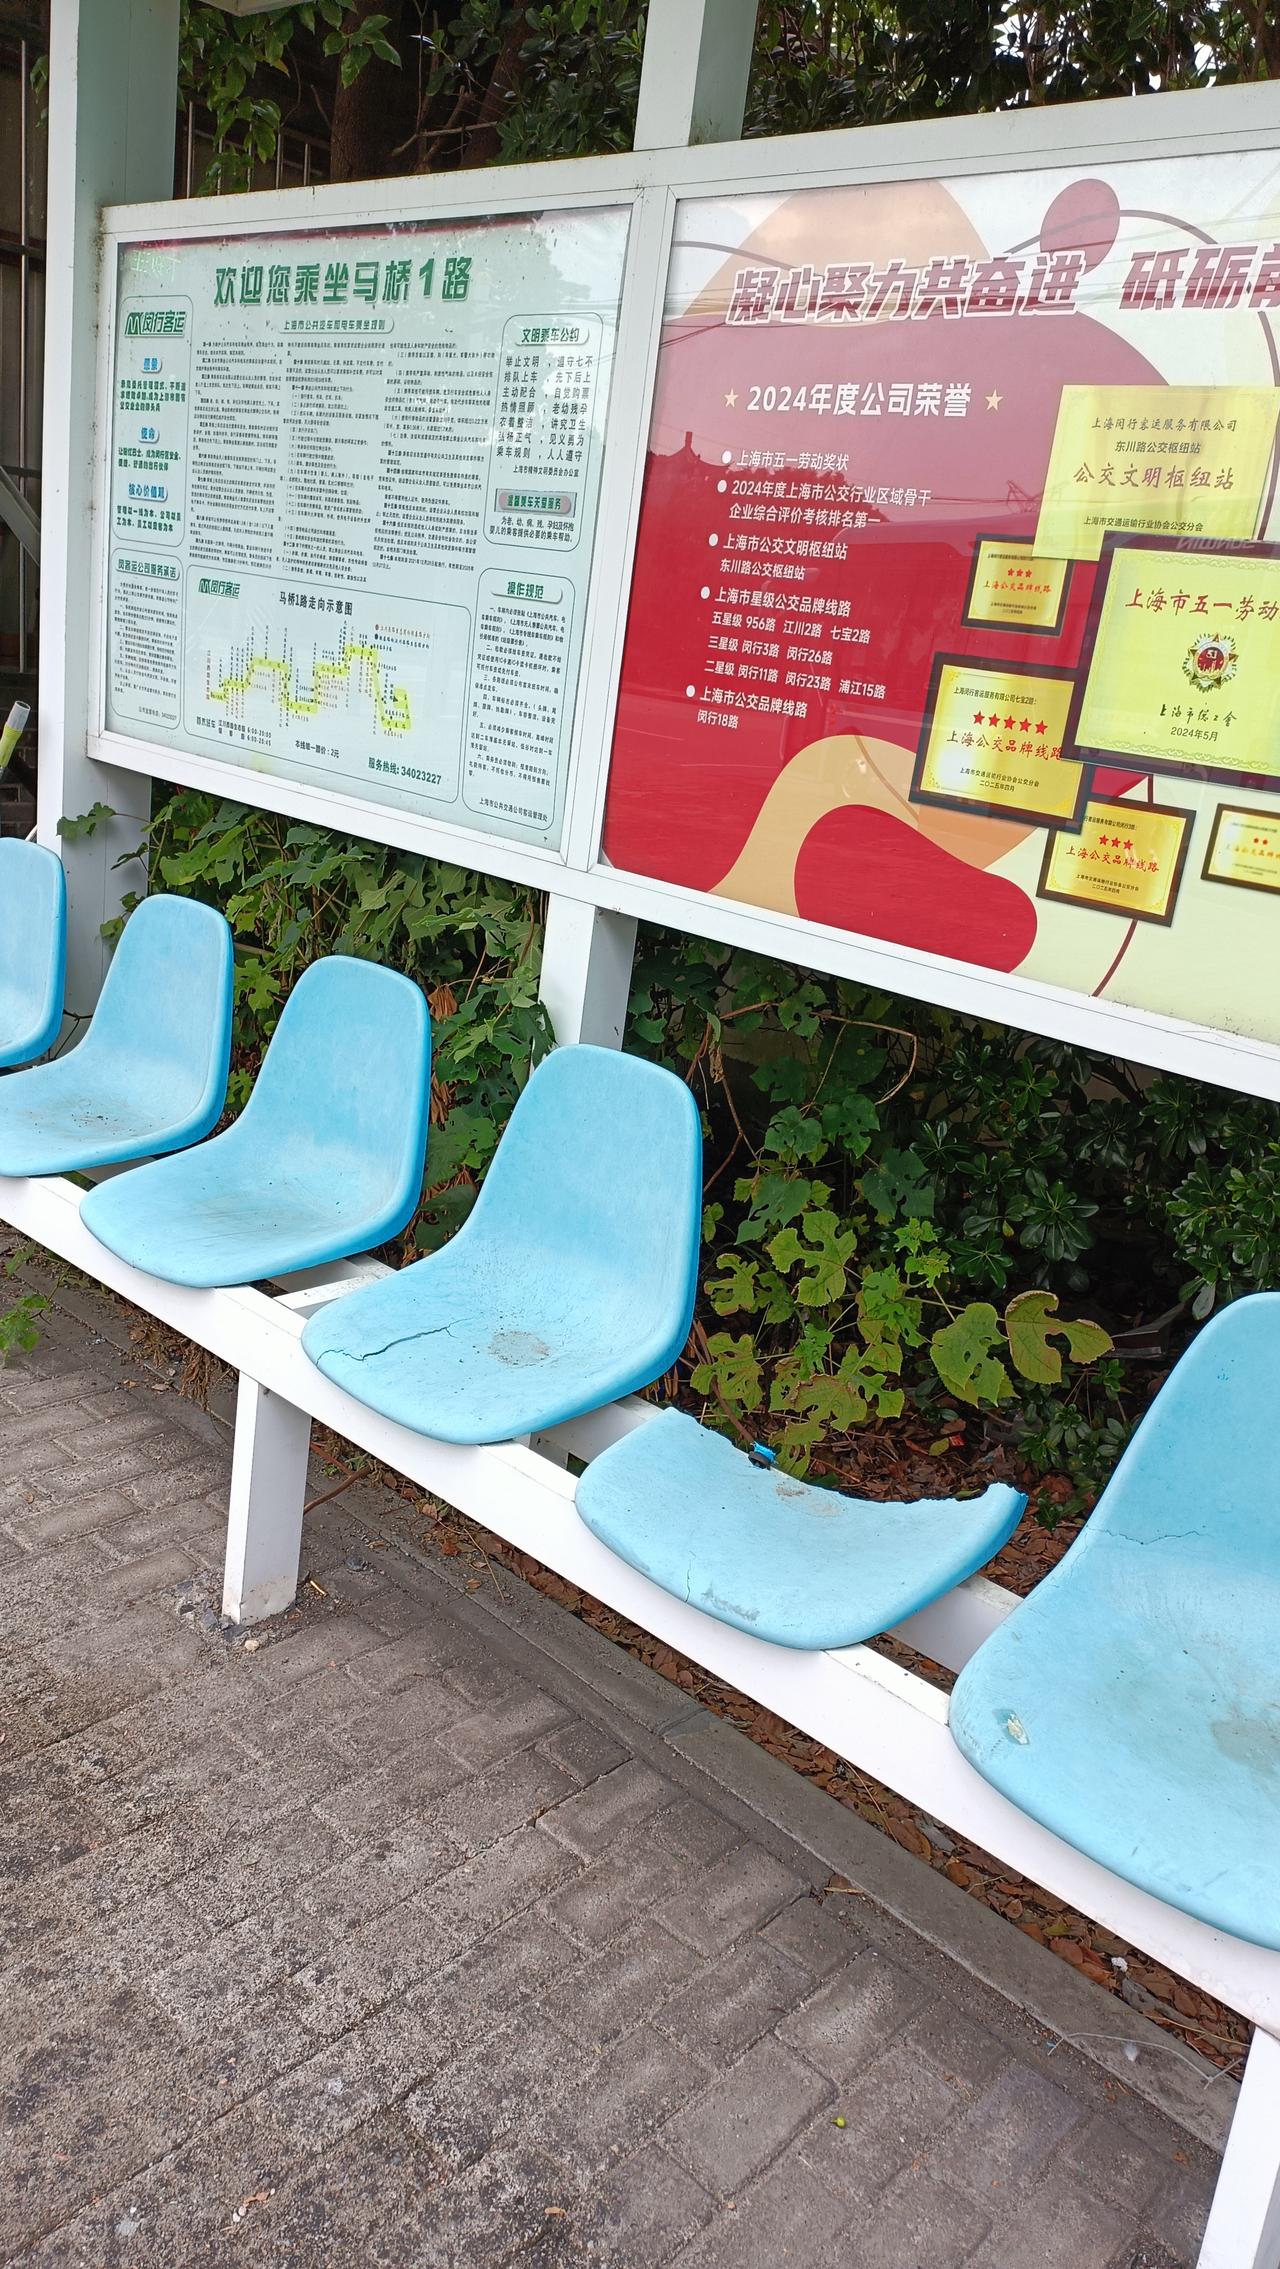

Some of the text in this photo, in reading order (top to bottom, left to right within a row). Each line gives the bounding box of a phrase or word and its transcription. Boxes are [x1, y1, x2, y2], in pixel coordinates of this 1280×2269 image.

[213, 256, 473, 306] 欢迎您乘坐马桥1路
[726, 250, 1084, 325] 凝心聚力共奋进
[142, 310, 187, 333] 闵行客运
[284, 319, 386, 331] 上海市公共汽车和电车乘坐规则
[521, 328, 580, 343] 文明乘车公约
[747, 382, 972, 417] 2024年度公司荣誉
[141, 427, 156, 440] 使命
[1091, 417, 1238, 432] 上海闵行客运服务有限公司
[1114, 440, 1201, 454] 东川路公交枢纽站
[737, 450, 849, 471] 上海市五一劳动奖状
[1072, 462, 1235, 490] 公交文明枢纽站
[128, 483, 165, 499] 核心价值观
[731, 479, 932, 507] 2024年度上海市公交行业区域骨干
[729, 502, 881, 529] 企业综合评价考核排名第一
[1083, 515, 1204, 533] 上海市交通运输行业协会公交分会
[723, 533, 848, 560] 上海市公交文明枢纽站
[719, 558, 806, 581] 东川路公交枢纽站
[210, 579, 241, 598] 闵行客运
[507, 581, 544, 599] 操作规范
[279, 591, 353, 616] 马桥1路走向示意图
[715, 586, 851, 618] 上海市星级公交品牌线路
[711, 611, 871, 644] 五星级 956路 江川2路 七宝2路
[708, 635, 833, 665] 三星级 闵行3路 闵行26路
[704, 660, 887, 700] 二星级 闵行11路 闵行23路 浦江15路
[699, 685, 808, 719] 上海市公交品牌线路
[697, 708, 740, 729] 闵行18路
[946, 729, 1062, 761] 上海公交品牌线路
[1170, 726, 1219, 742] 2024年5月
[1065, 845, 1160, 873] 上海公交品牌线路
